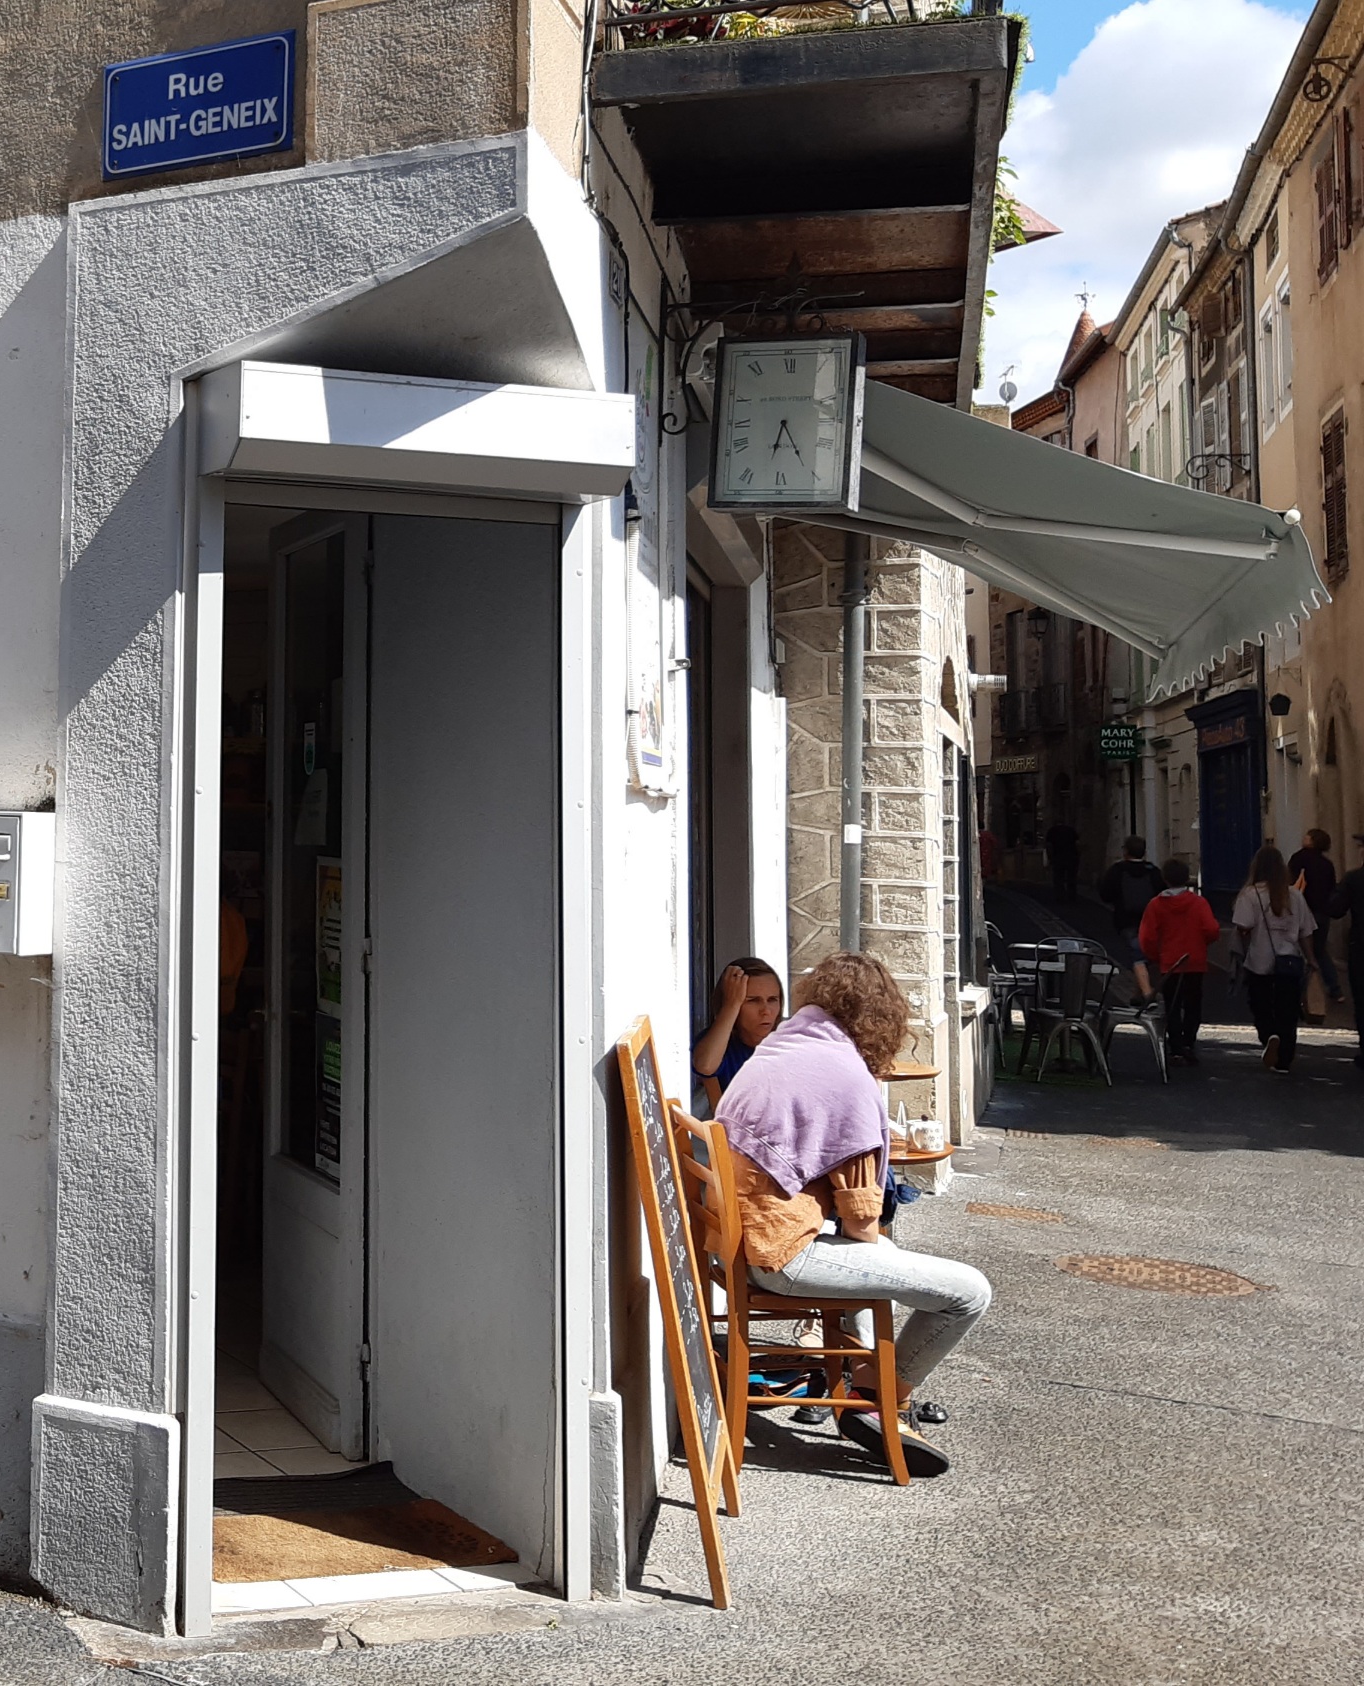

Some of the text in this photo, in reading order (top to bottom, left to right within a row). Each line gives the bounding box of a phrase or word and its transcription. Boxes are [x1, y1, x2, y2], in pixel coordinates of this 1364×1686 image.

[168, 72, 224, 100] Rue
[111, 96, 278, 151] SAINT-GENEIX
[1101, 728, 1135, 737] MARY
[1101, 739, 1135, 748] COHR
